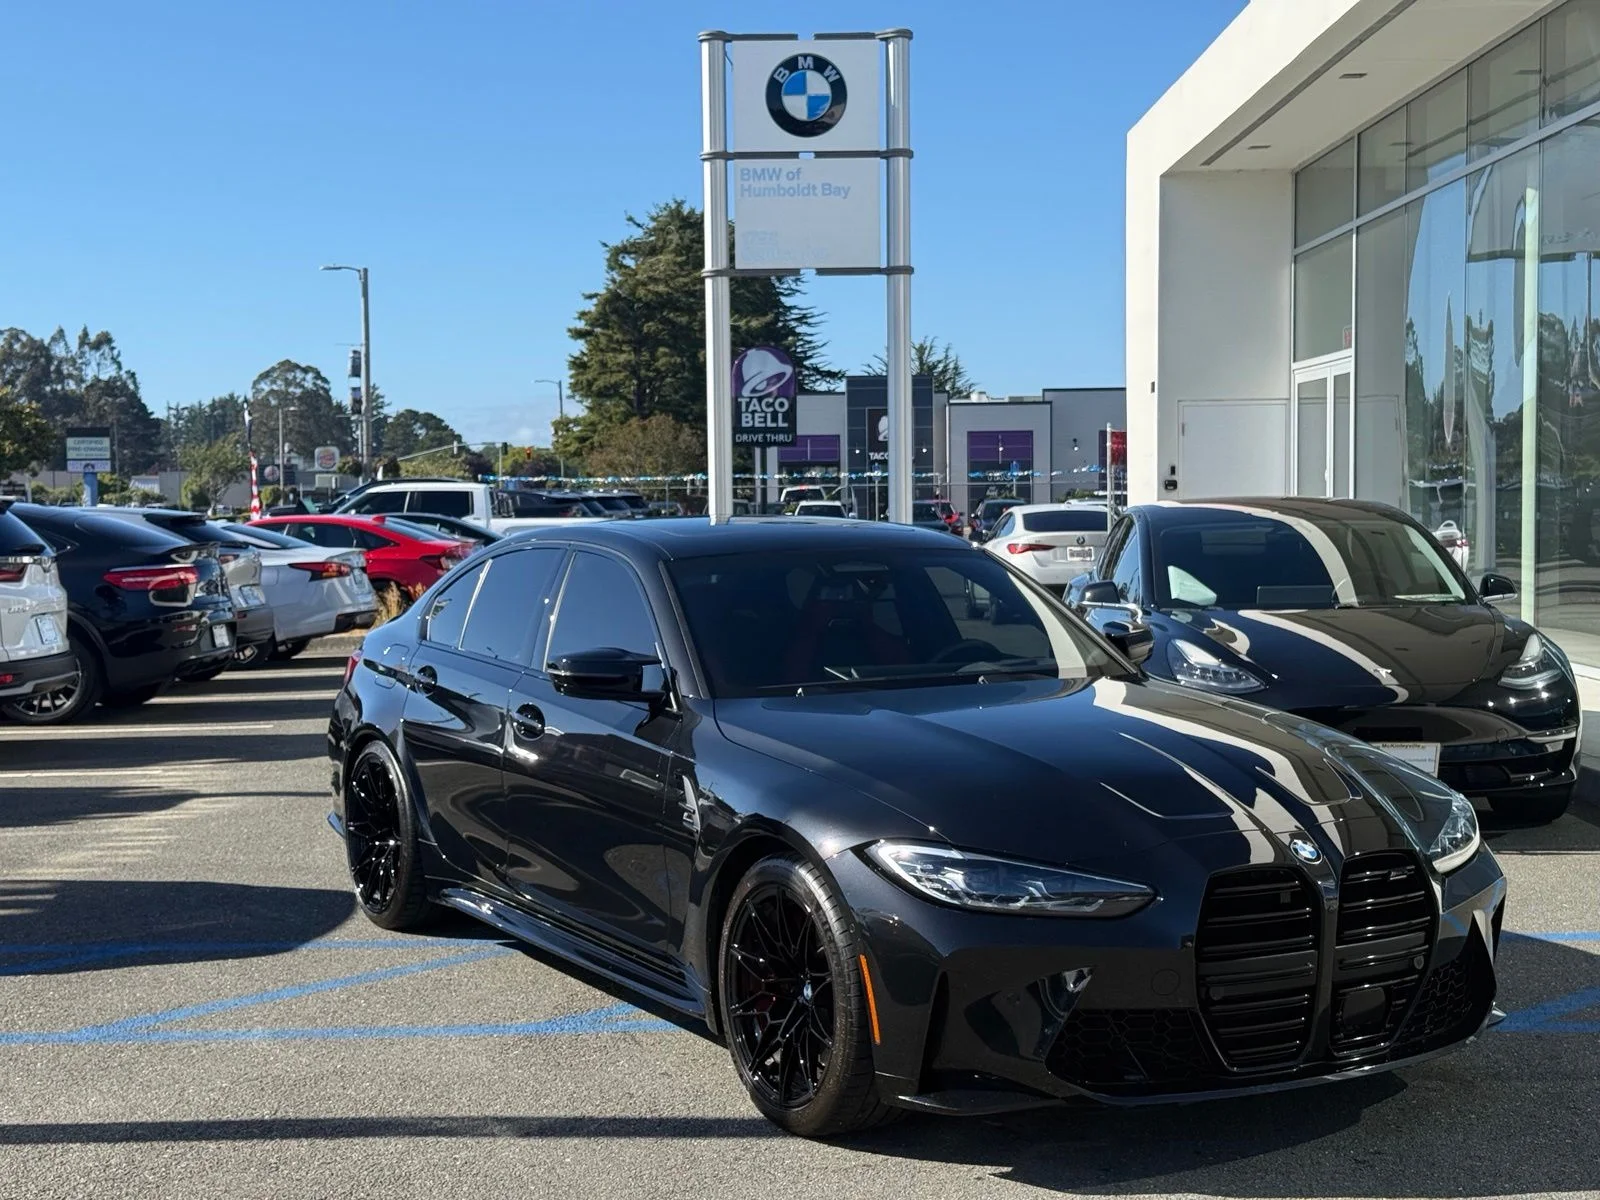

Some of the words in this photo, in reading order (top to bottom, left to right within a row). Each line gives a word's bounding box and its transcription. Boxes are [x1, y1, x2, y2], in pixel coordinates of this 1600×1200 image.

[773, 56, 841, 84] BMW
[740, 167, 782, 182] BMW
[786, 167, 803, 181] of
[740, 183, 818, 198] Humboldt
[821, 183, 851, 199] Bay
[738, 398, 789, 413] TACO
[741, 412, 788, 427] BELL
[735, 434, 764, 443] DRIVE
[766, 433, 792, 443] THRU
